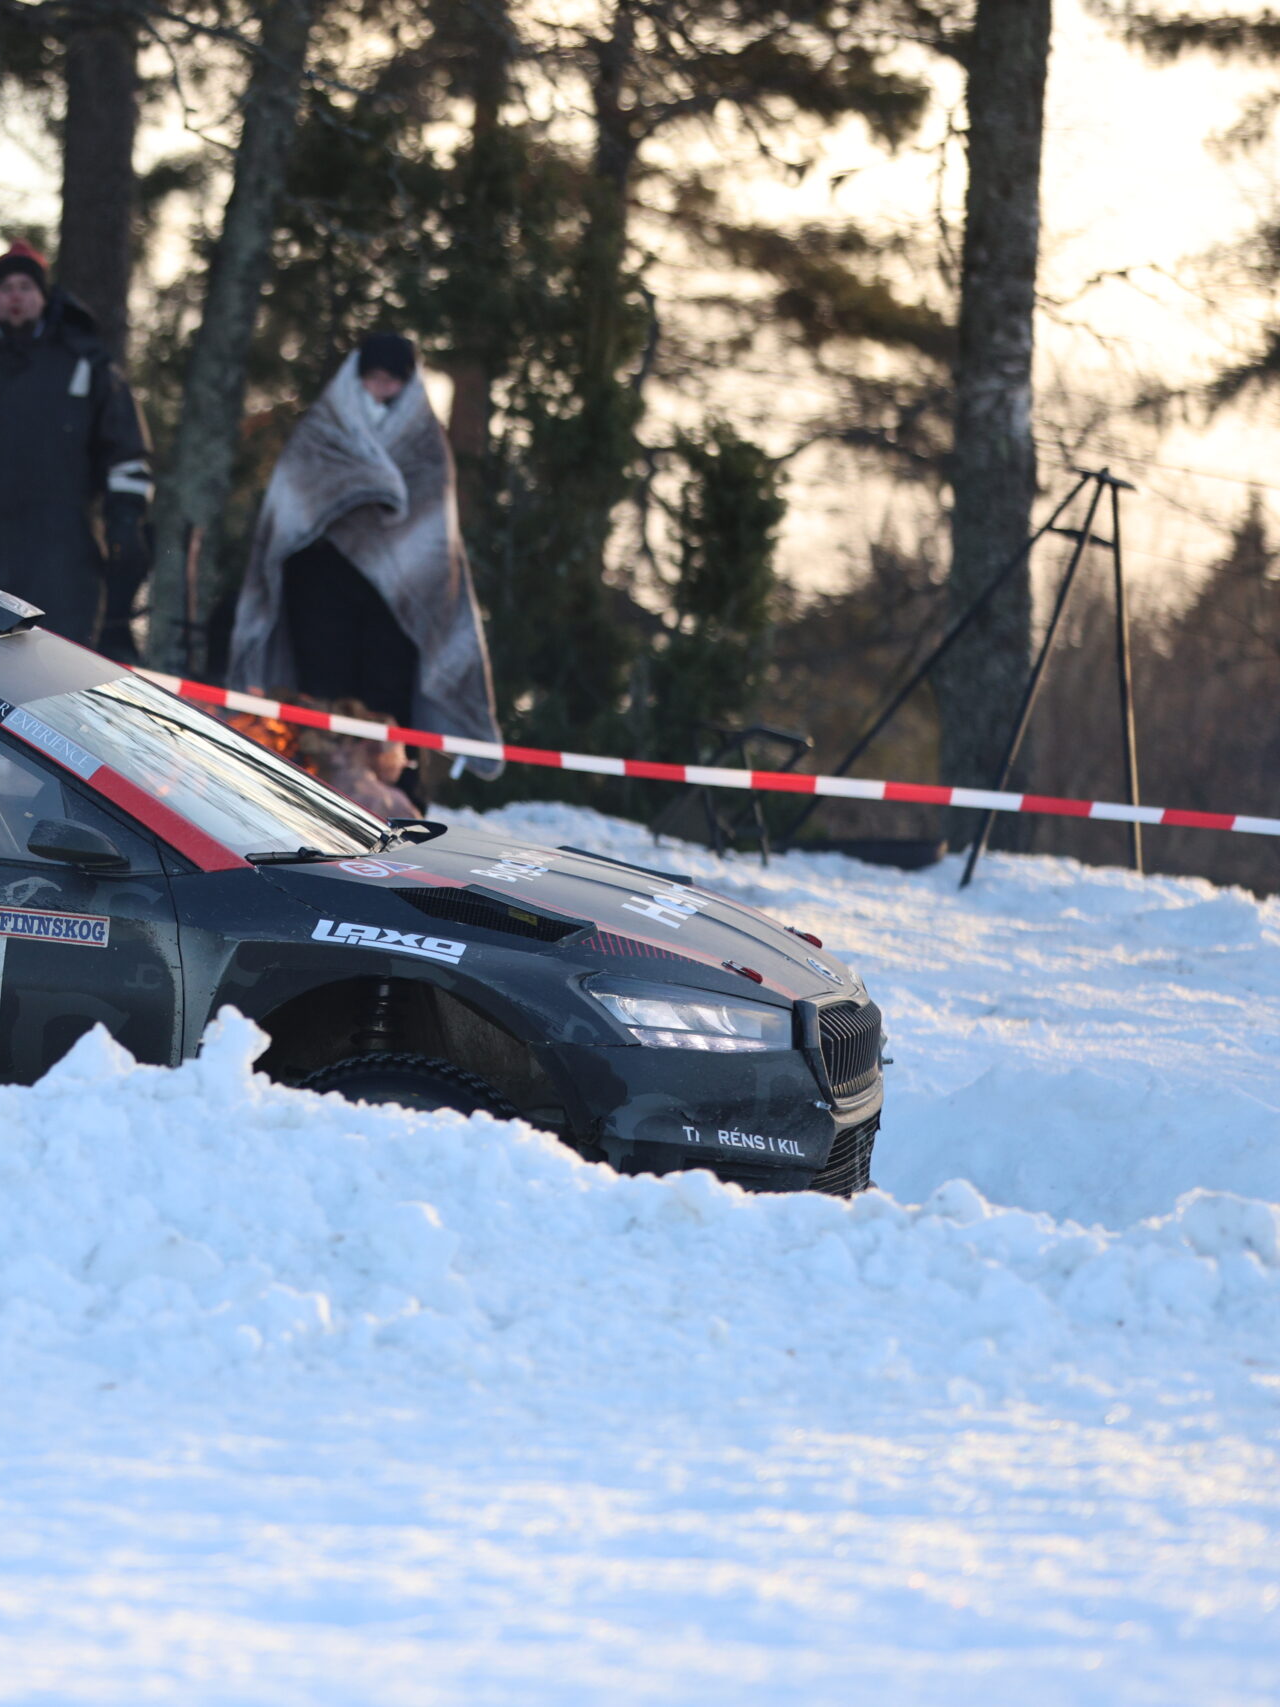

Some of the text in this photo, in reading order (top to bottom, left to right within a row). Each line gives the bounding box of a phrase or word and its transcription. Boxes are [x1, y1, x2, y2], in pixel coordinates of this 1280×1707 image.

[8, 710, 90, 769] EXPERIENCE
[311, 918, 467, 965] LAXO
[777, 1138, 806, 1157] KIL
